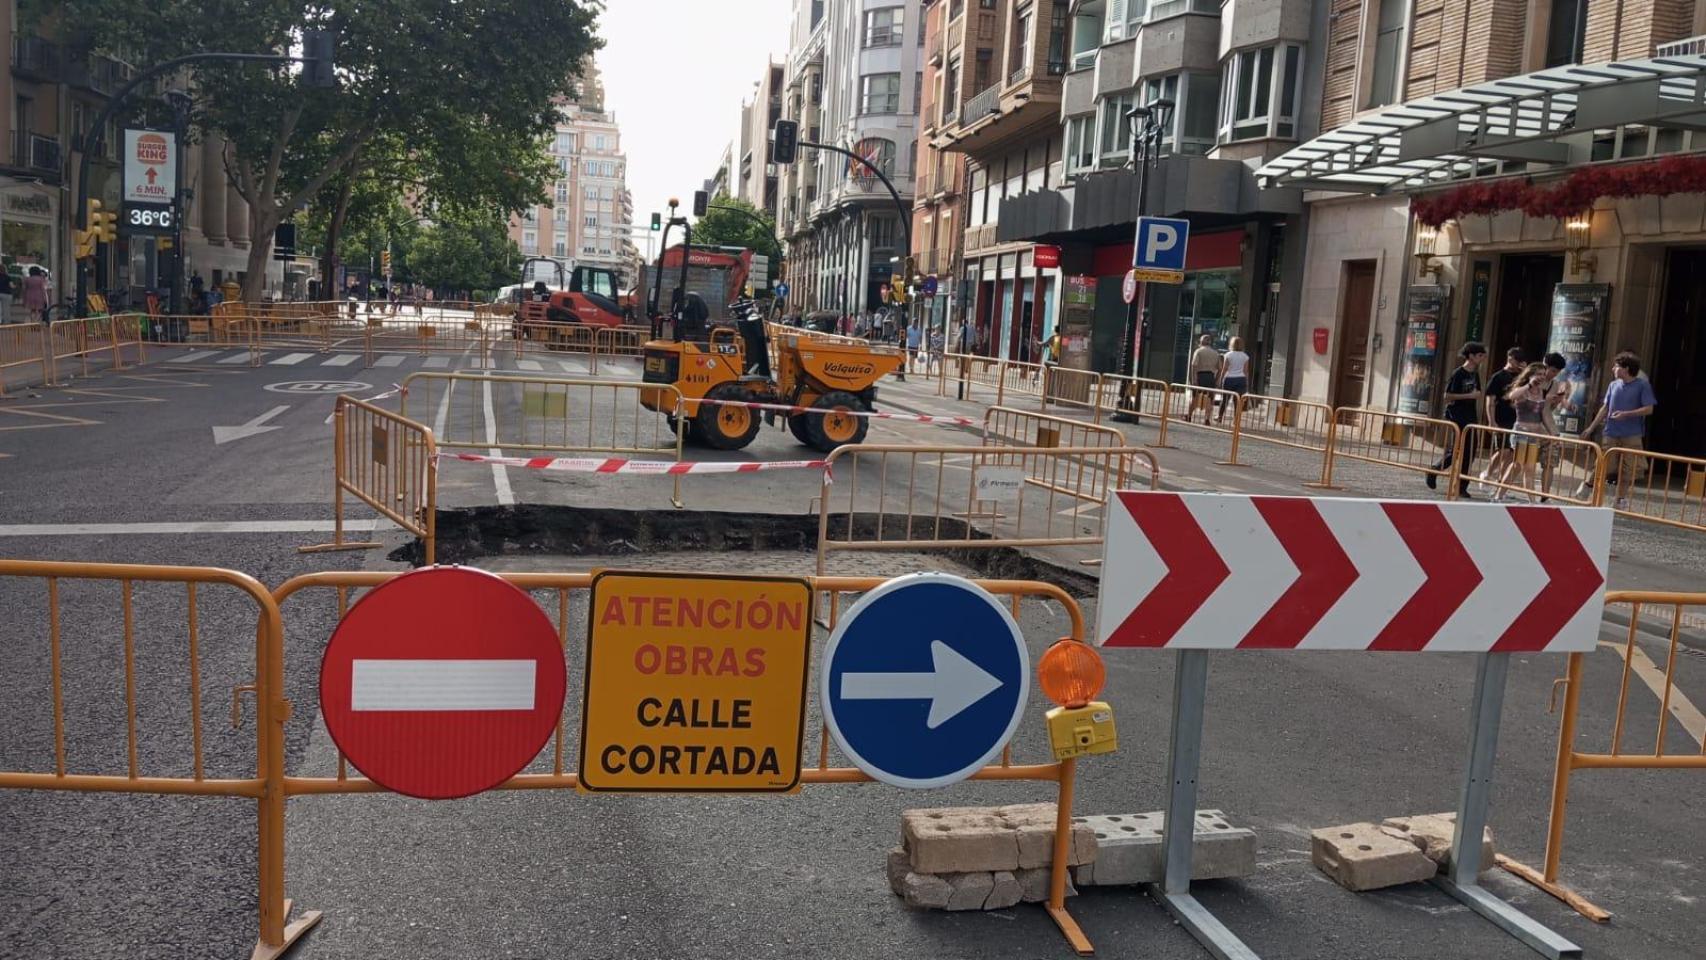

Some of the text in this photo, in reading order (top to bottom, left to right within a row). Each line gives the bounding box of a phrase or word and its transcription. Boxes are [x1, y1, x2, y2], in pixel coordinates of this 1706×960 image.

[137, 142, 167, 151] BURGER
[137, 150, 167, 160] KING
[136, 184, 167, 195] 6 MIN.
[130, 209, 170, 227] 36°C
[1145, 223, 1178, 263] P
[824, 360, 872, 375] Valquisa
[685, 374, 710, 383] 4101
[601, 593, 803, 631] ATENCIÓN
[634, 643, 766, 678] OBRAS
[637, 697, 752, 728] CALLE
[601, 744, 780, 775] CORTADA
